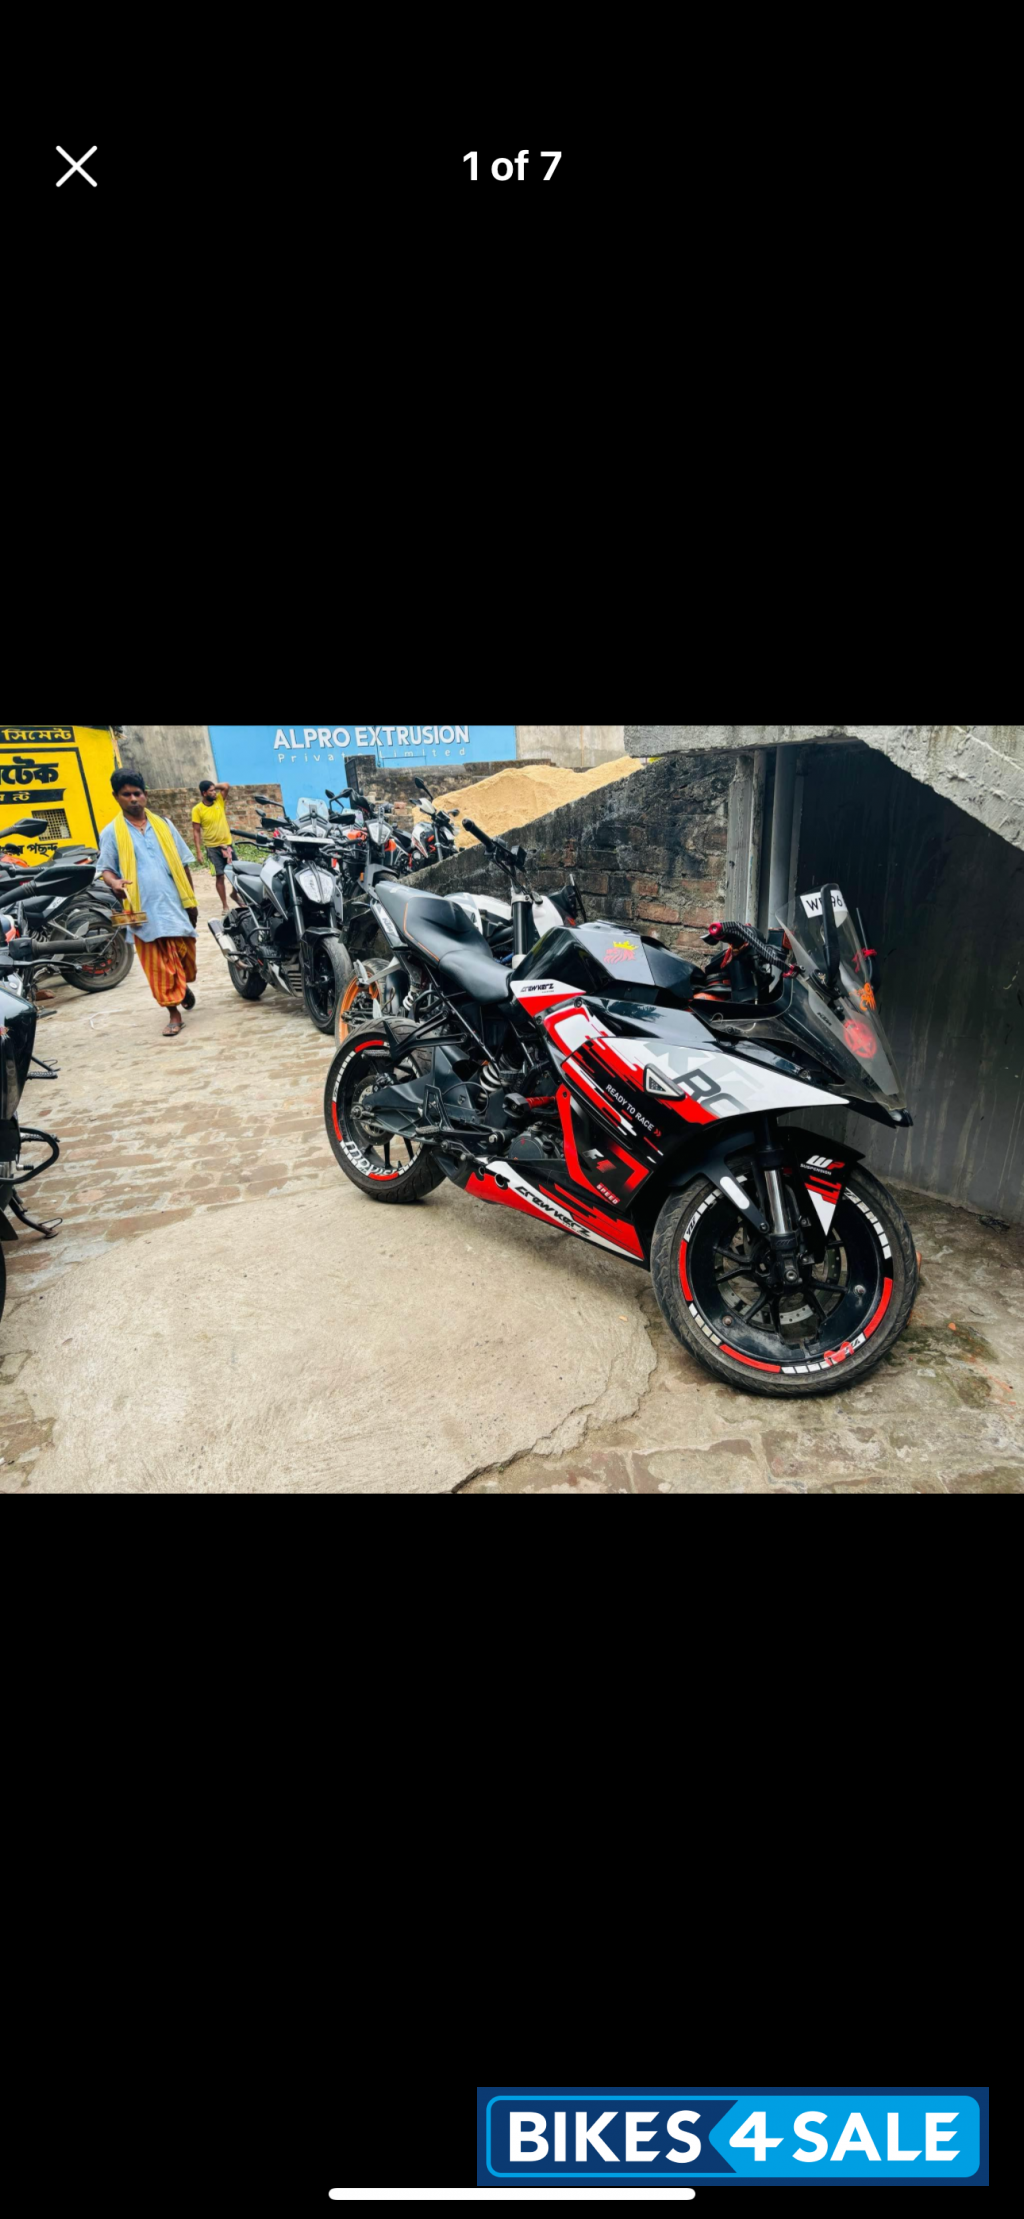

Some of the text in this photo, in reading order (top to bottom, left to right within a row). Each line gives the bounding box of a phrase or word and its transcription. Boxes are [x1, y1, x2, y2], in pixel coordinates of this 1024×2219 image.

[273, 725, 470, 749] ALPRO EXTRUSION
[379, 747, 466, 759] Limited
[0, 756, 59, 785] টেক
[605, 1084, 655, 1132] READY TO RACE
[596, 1182, 620, 1205] SPEED
